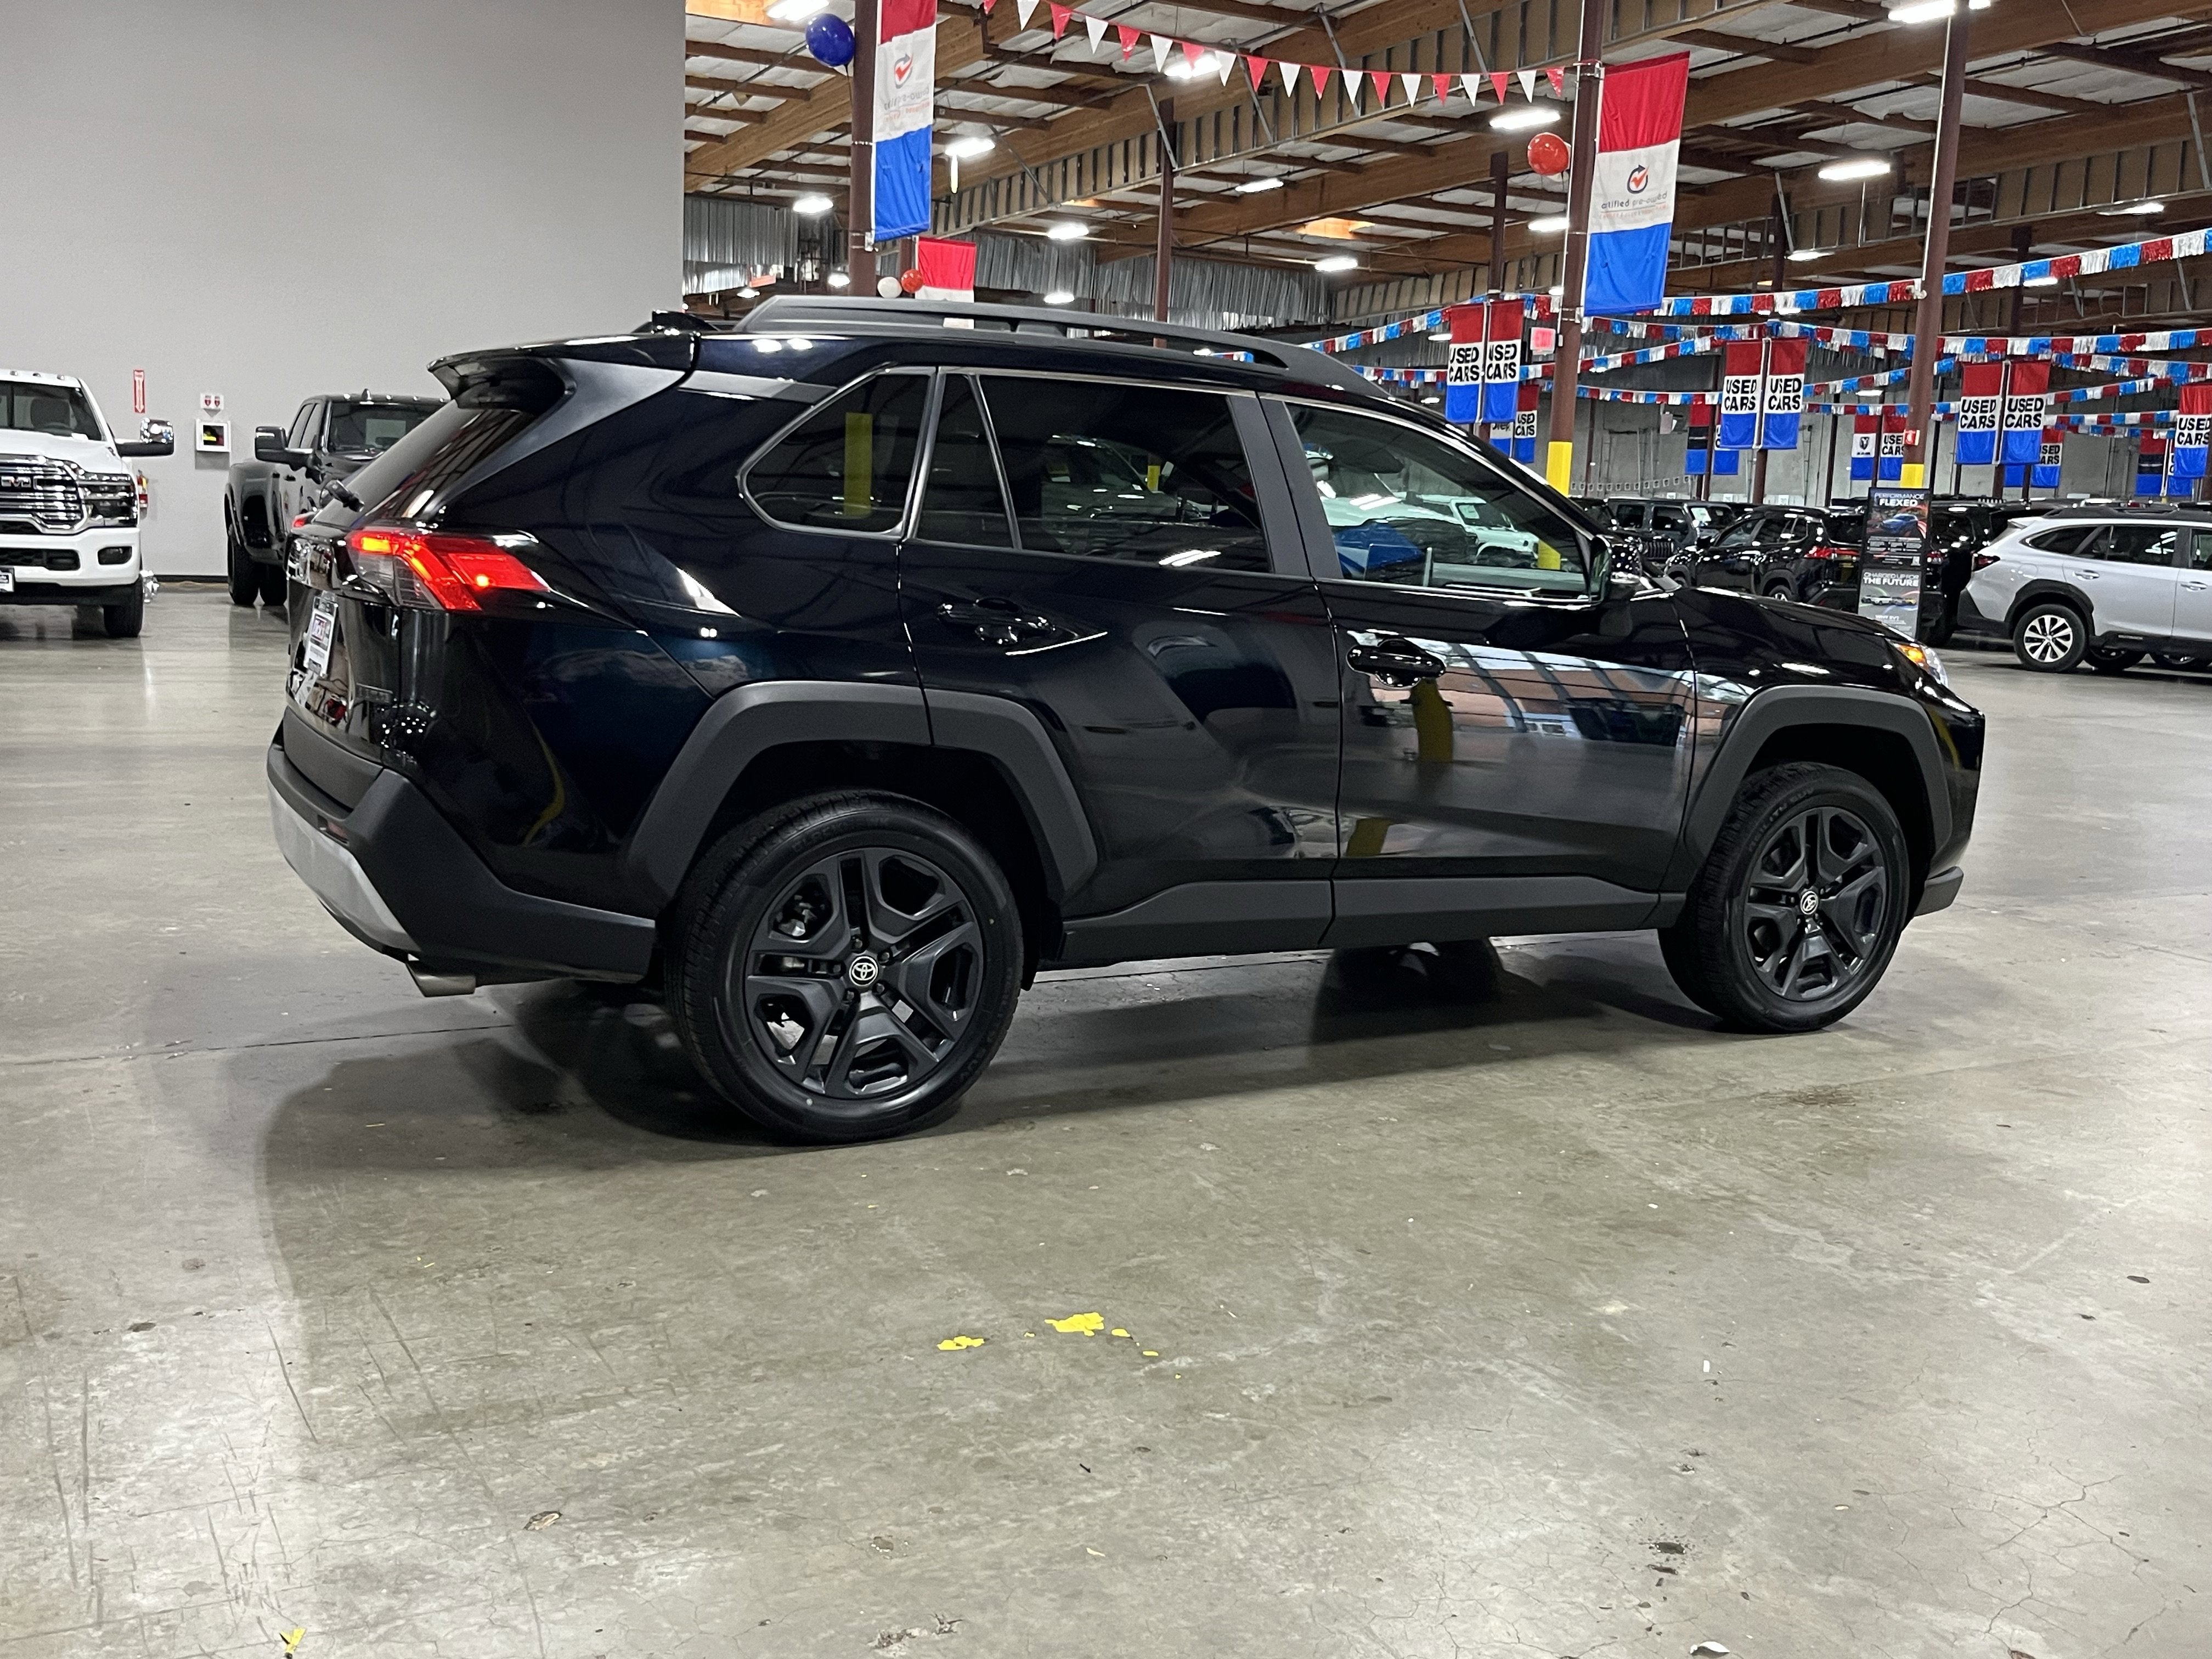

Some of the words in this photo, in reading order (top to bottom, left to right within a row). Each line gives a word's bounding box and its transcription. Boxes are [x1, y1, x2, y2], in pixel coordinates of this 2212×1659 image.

[1450, 347, 1480, 364] USED
[1488, 344, 1517, 362] USED
[1449, 365, 1480, 382] CARS
[1487, 362, 1517, 380] CARS
[1726, 379, 1757, 394] USED
[1770, 378, 1802, 393] USED
[1724, 396, 1756, 411] CARS
[1768, 395, 1801, 410] CARS
[1961, 399, 1996, 414] USED
[2007, 398, 2044, 412] USED
[1960, 415, 1995, 429] CARS
[2005, 414, 2041, 428] CARS
[1884, 435, 1903, 444] USE
[2177, 432, 2210, 445] CARS
[2040, 445, 2060, 454] SED
[2040, 455, 2059, 465] ARS
[1879, 499, 1918, 507] FLEXED
[1882, 578, 1918, 586] FUTURE
